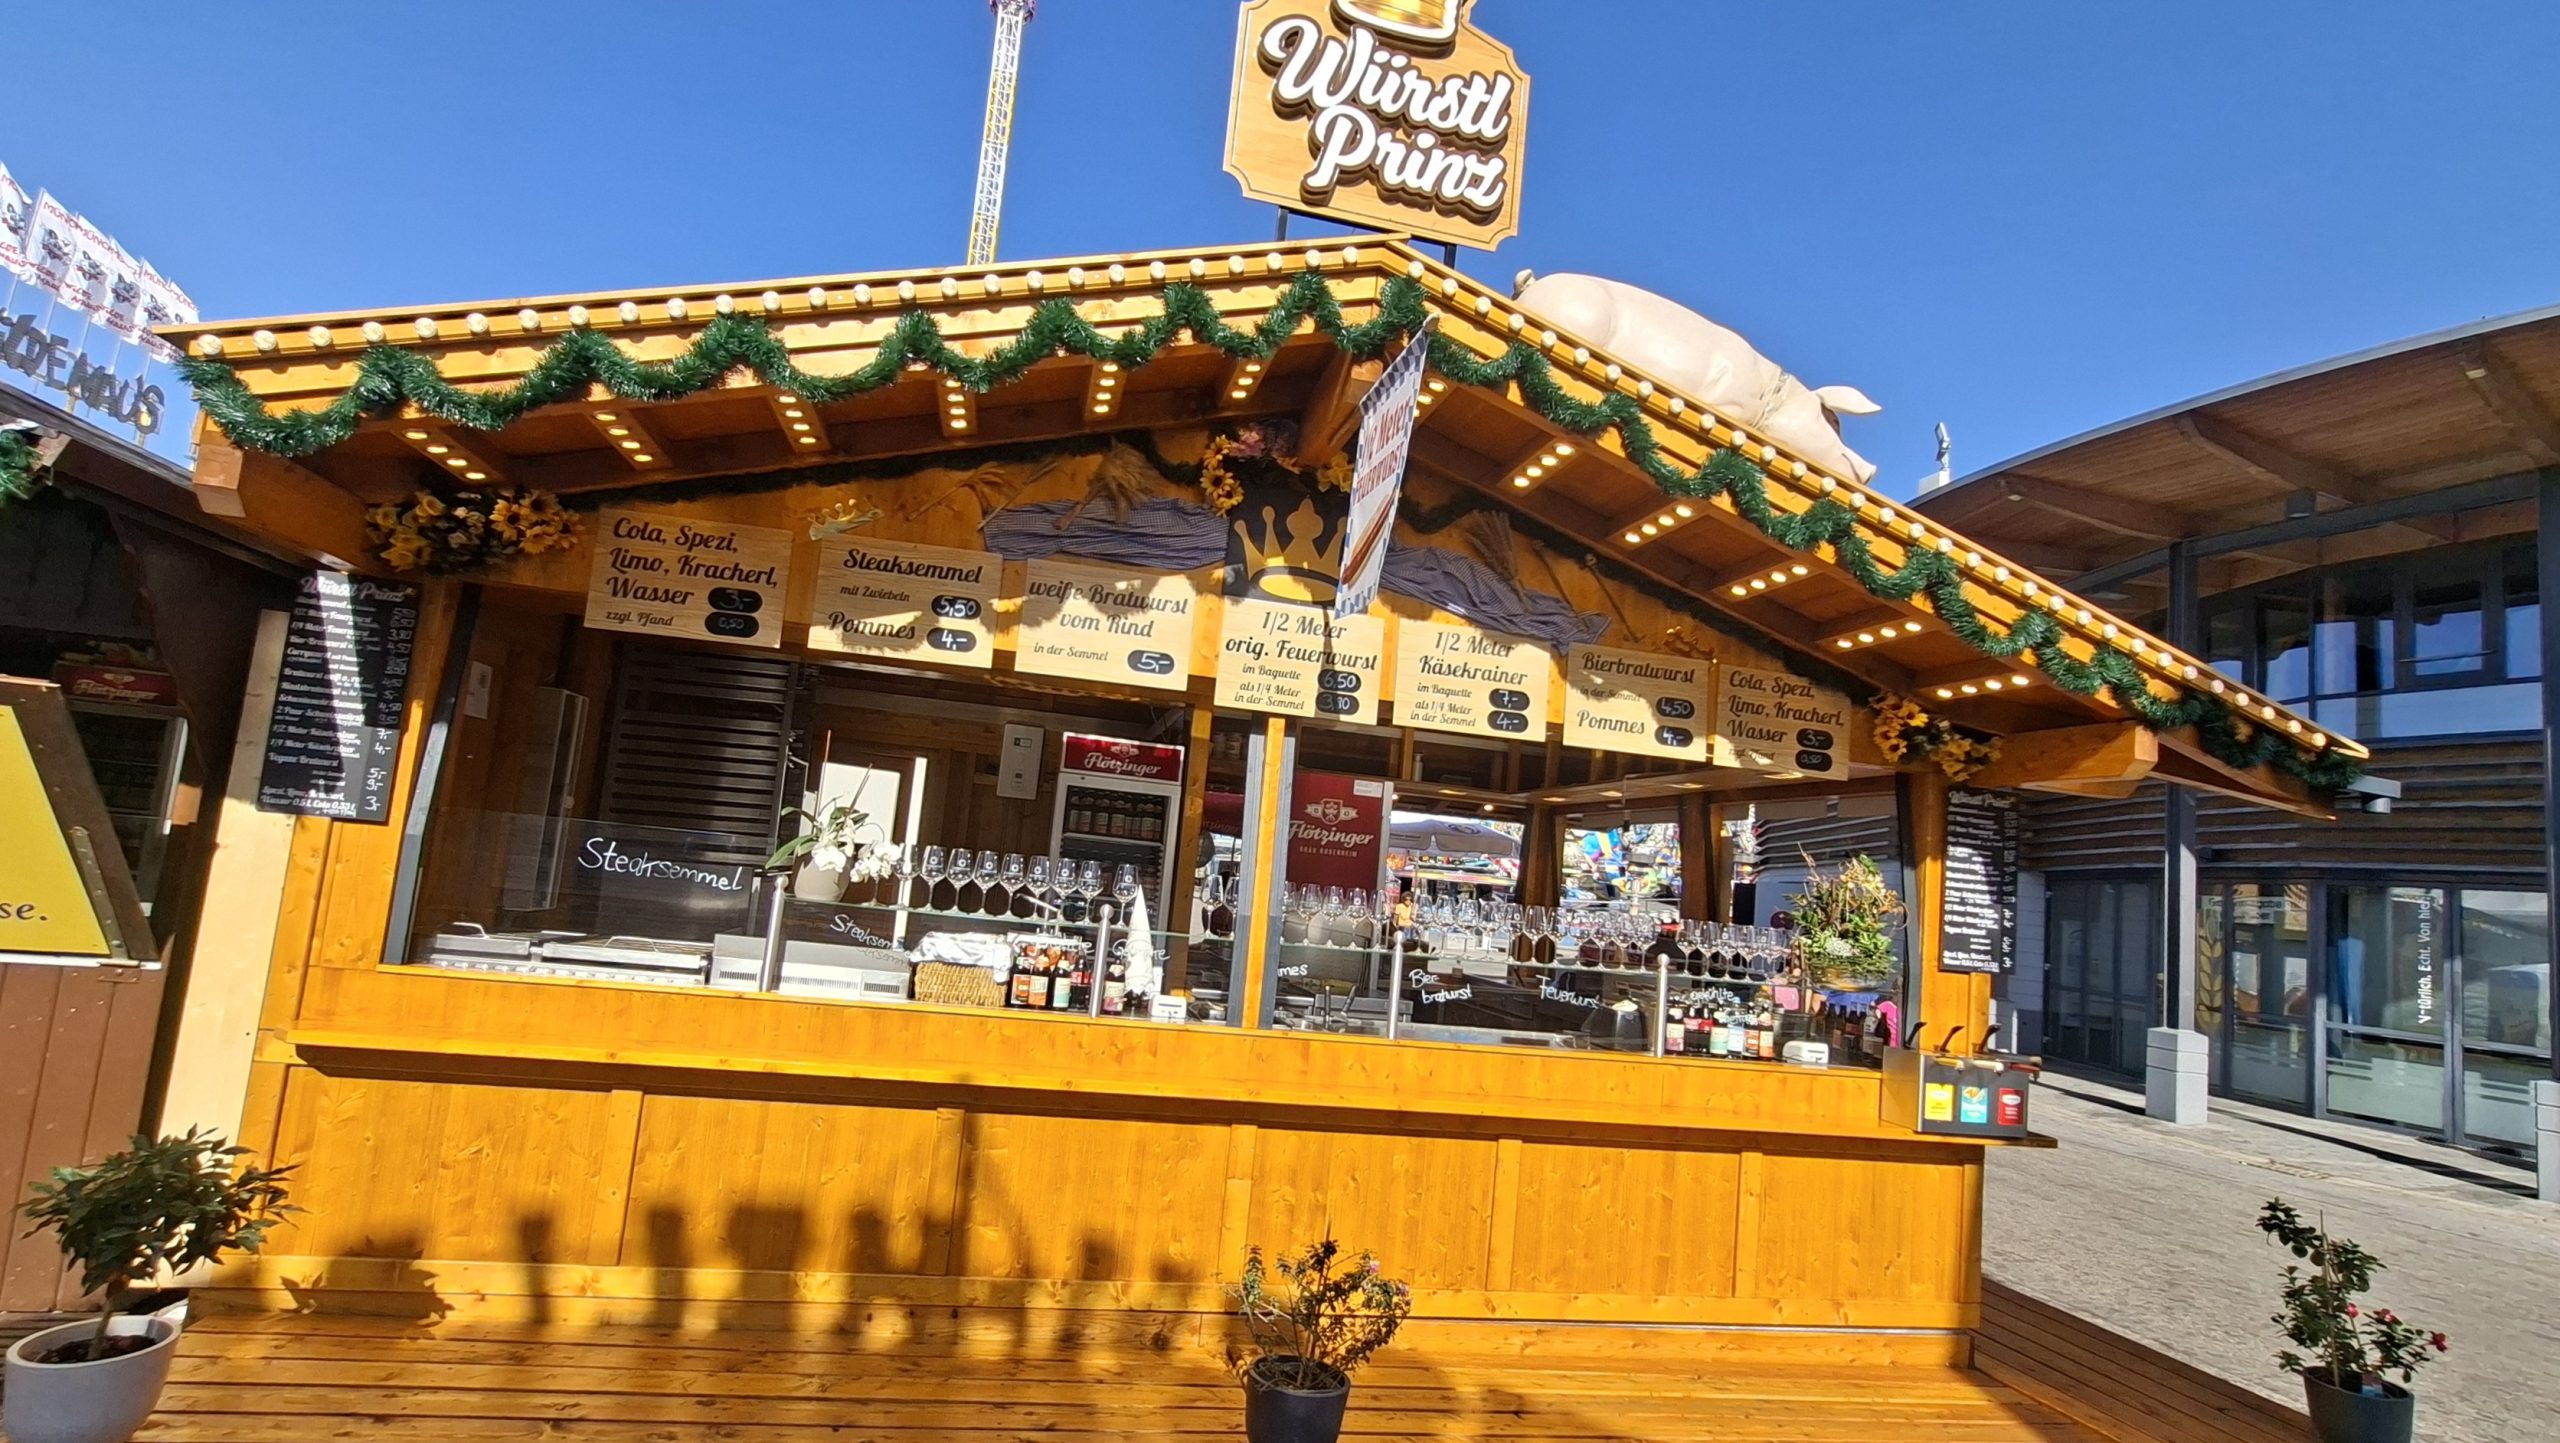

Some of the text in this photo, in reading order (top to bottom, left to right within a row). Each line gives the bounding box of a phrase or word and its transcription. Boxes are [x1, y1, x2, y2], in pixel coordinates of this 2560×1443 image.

[1261, 16, 1514, 142] Würstl
[1304, 103, 1506, 208] Prinz
[613, 517, 738, 553] Cola, Spezi,
[677, 555, 778, 589] Kracherl,
[843, 548, 984, 584] Steaksemmel
[606, 576, 695, 605] Wasser
[840, 585, 976, 617] mit Zwiebeln 5,50
[1089, 584, 1188, 615] Bratwurst
[637, 612, 674, 627] Pfand
[828, 611, 916, 640] Pommes
[1059, 613, 1155, 637] vom Rind
[1262, 611, 1347, 639] 1/2 Meter
[1033, 642, 1045, 654] in
[1047, 644, 1064, 656] der
[1066, 646, 1109, 661] Semmel
[1225, 636, 1378, 671] orig. Feuerwurst
[1435, 631, 1515, 658] 1/2 Meter
[1242, 663, 1357, 689] im Baguette 6,50
[1419, 655, 1528, 686] Käsekrainer
[1582, 651, 1696, 684] Bierbratwurst
[1239, 681, 1301, 698] als 1/4 Meter
[1417, 682, 1429, 693] im
[1431, 683, 1472, 698] Baguette
[1580, 686, 1589, 696] in
[1590, 687, 1605, 698] der
[1729, 670, 1815, 698] Cola, Spezi,
[1234, 692, 1245, 703] in
[1246, 694, 1263, 705] der
[1265, 695, 1305, 710] Semmel
[1415, 700, 1472, 715] als 1/4 Meter
[1774, 700, 1844, 727] Kracherl,
[1410, 710, 1420, 721] in
[1422, 712, 1437, 723] der
[1439, 714, 1476, 727] Semmel
[1577, 709, 1645, 734] Pommes
[1727, 719, 1788, 743] Wasser
[1085, 752, 1161, 776] Flötzinger
[1288, 820, 1374, 847] Flötzinger
[578, 837, 743, 891] Steaksemmel
[2417, 922, 2431, 942] Von
